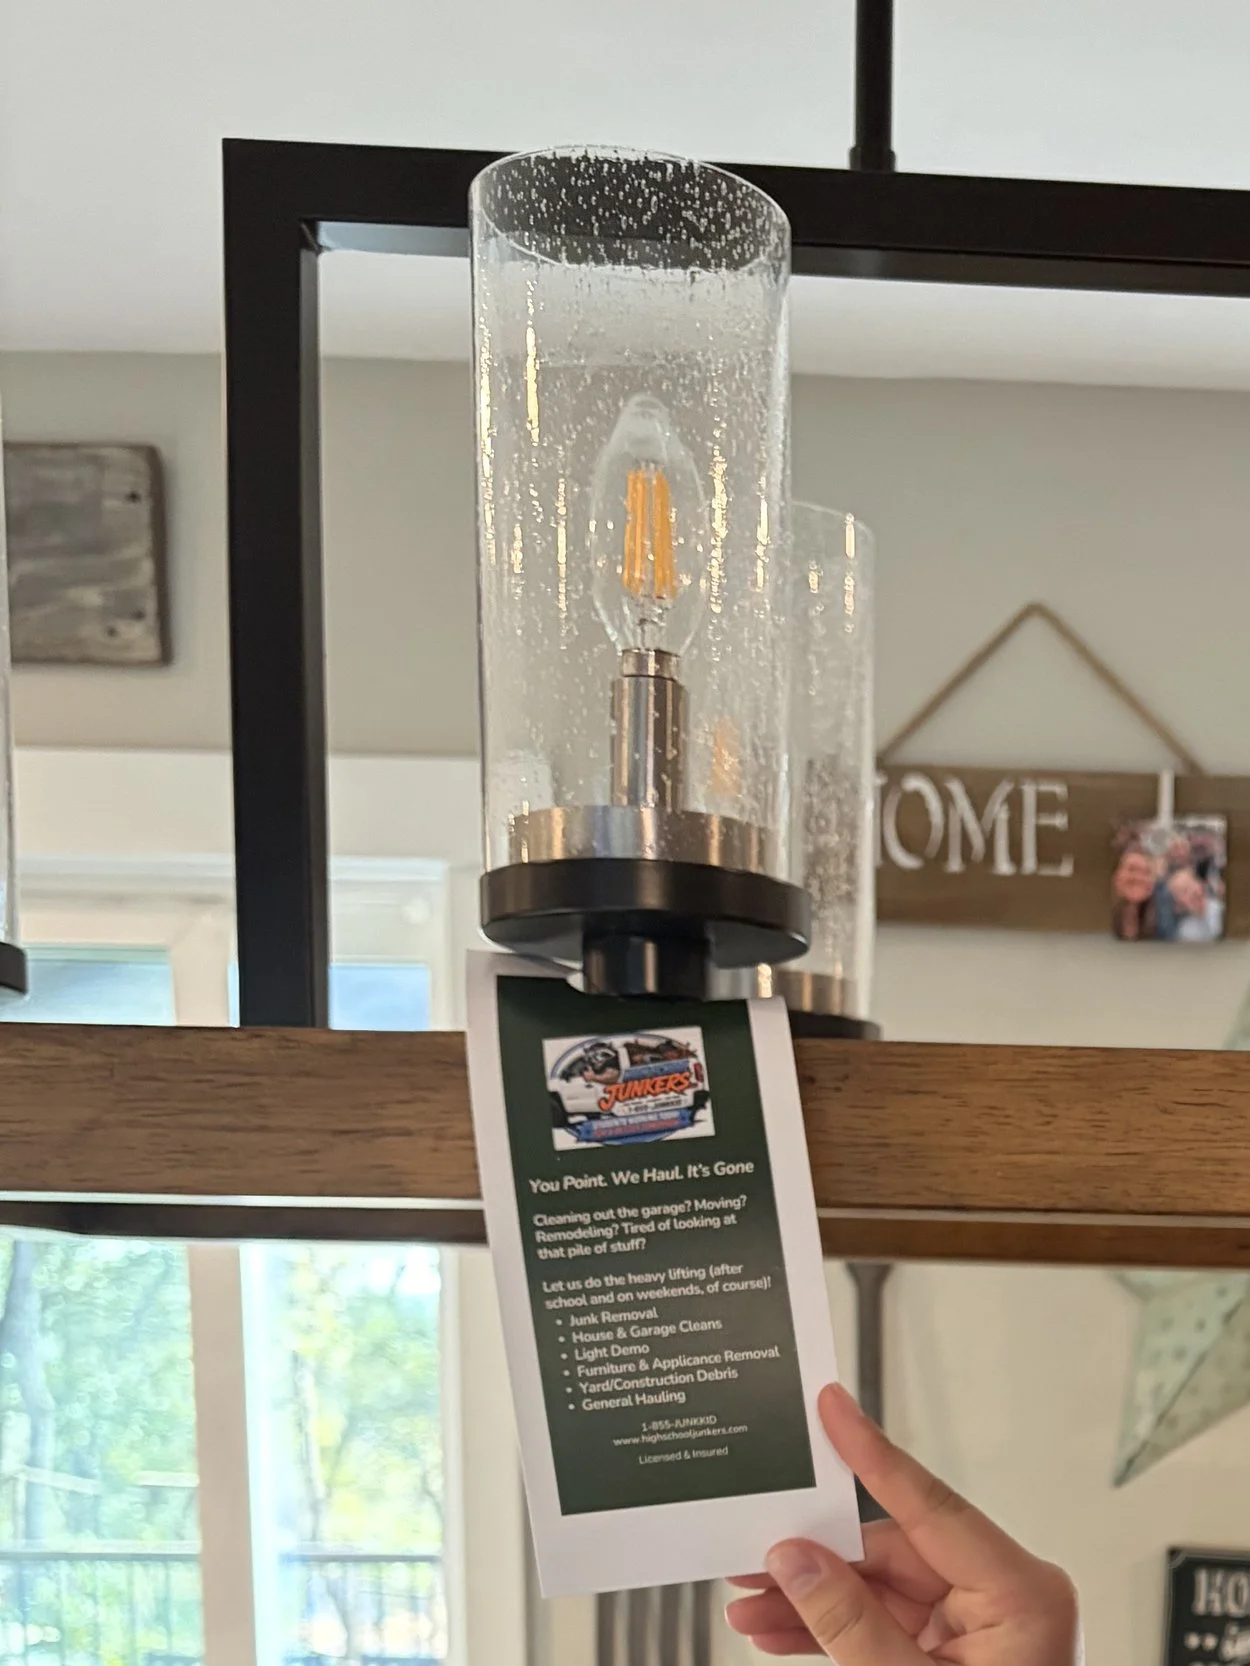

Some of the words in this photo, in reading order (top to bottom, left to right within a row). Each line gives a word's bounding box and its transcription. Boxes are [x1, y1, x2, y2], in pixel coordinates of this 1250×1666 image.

[598, 1071, 692, 1111] JUNKERS
[529, 1176, 560, 1193] You
[563, 1173, 607, 1190] Point.
[611, 1170, 640, 1185] We
[643, 1166, 684, 1183] Haul.
[687, 1163, 711, 1178] It's
[713, 1160, 755, 1176] Gone
[533, 1210, 591, 1227] Cleaning
[593, 1209, 615, 1222] out
[617, 1206, 639, 1219] the
[641, 1201, 692, 1219] garage?
[694, 1195, 747, 1212] Moving?
[535, 1224, 619, 1243] Remodeling?
[621, 1220, 655, 1236] Tired
[657, 1218, 672, 1231] of
[673, 1214, 721, 1231] looking
[723, 1214, 738, 1226] at
[537, 1246, 564, 1260] that
[567, 1243, 592, 1261] pile
[594, 1240, 608, 1254] of
[610, 1238, 647, 1252] stuff?
[542, 1280, 564, 1293] Let
[567, 1279, 583, 1290] us
[585, 1276, 602, 1289] do
[604, 1273, 626, 1286] the
[628, 1271, 666, 1286] heavy
[668, 1266, 706, 1281] lifting
[709, 1263, 744, 1278] (after
[545, 1295, 589, 1310] school
[590, 1292, 615, 1306] and
[617, 1291, 634, 1303] on
[636, 1283, 705, 1301] weekends,
[706, 1281, 721, 1294] of
[722, 1275, 772, 1293] course)!
[569, 1313, 599, 1328] Junk
[601, 1307, 659, 1324] Removal
[572, 1330, 614, 1344] House
[616, 1327, 628, 1340] &
[630, 1323, 677, 1339] Garage
[679, 1318, 723, 1333] Cleans
[574, 1347, 609, 1362] Light
[611, 1344, 650, 1358] Demo
[577, 1362, 638, 1378] Furniture
[639, 1359, 650, 1372] &
[652, 1354, 722, 1372] Applicance
[724, 1345, 780, 1362] Removal
[579, 1373, 695, 1395] Yard/Construction
[696, 1367, 739, 1382] Debris
[582, 1396, 633, 1411] General
[635, 1390, 687, 1406] Hauling
[638, 1451, 682, 1465] Licensed
[683, 1449, 692, 1460] &
[692, 1446, 729, 1459] Insured
